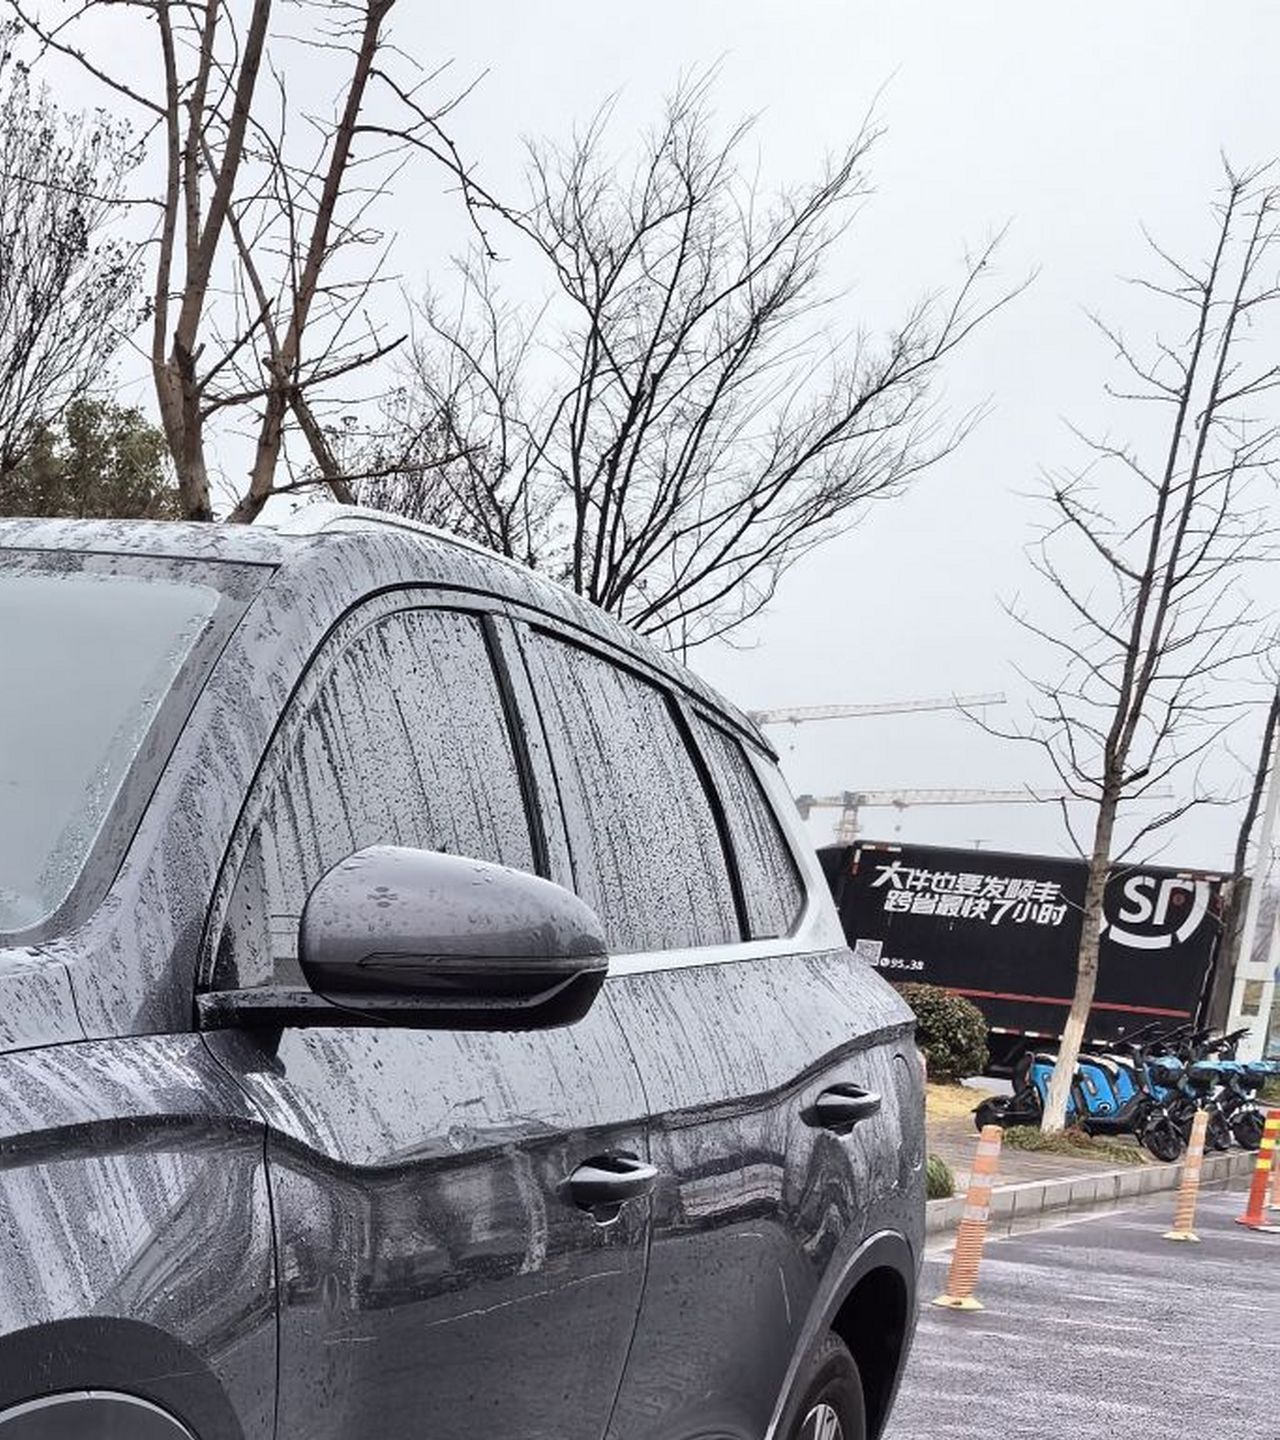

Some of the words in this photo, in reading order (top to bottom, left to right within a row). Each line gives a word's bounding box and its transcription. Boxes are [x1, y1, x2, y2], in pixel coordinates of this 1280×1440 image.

[870, 861, 1061, 902] 大件也要发顺丰
[884, 890, 1067, 926] 跨省最快7小时
